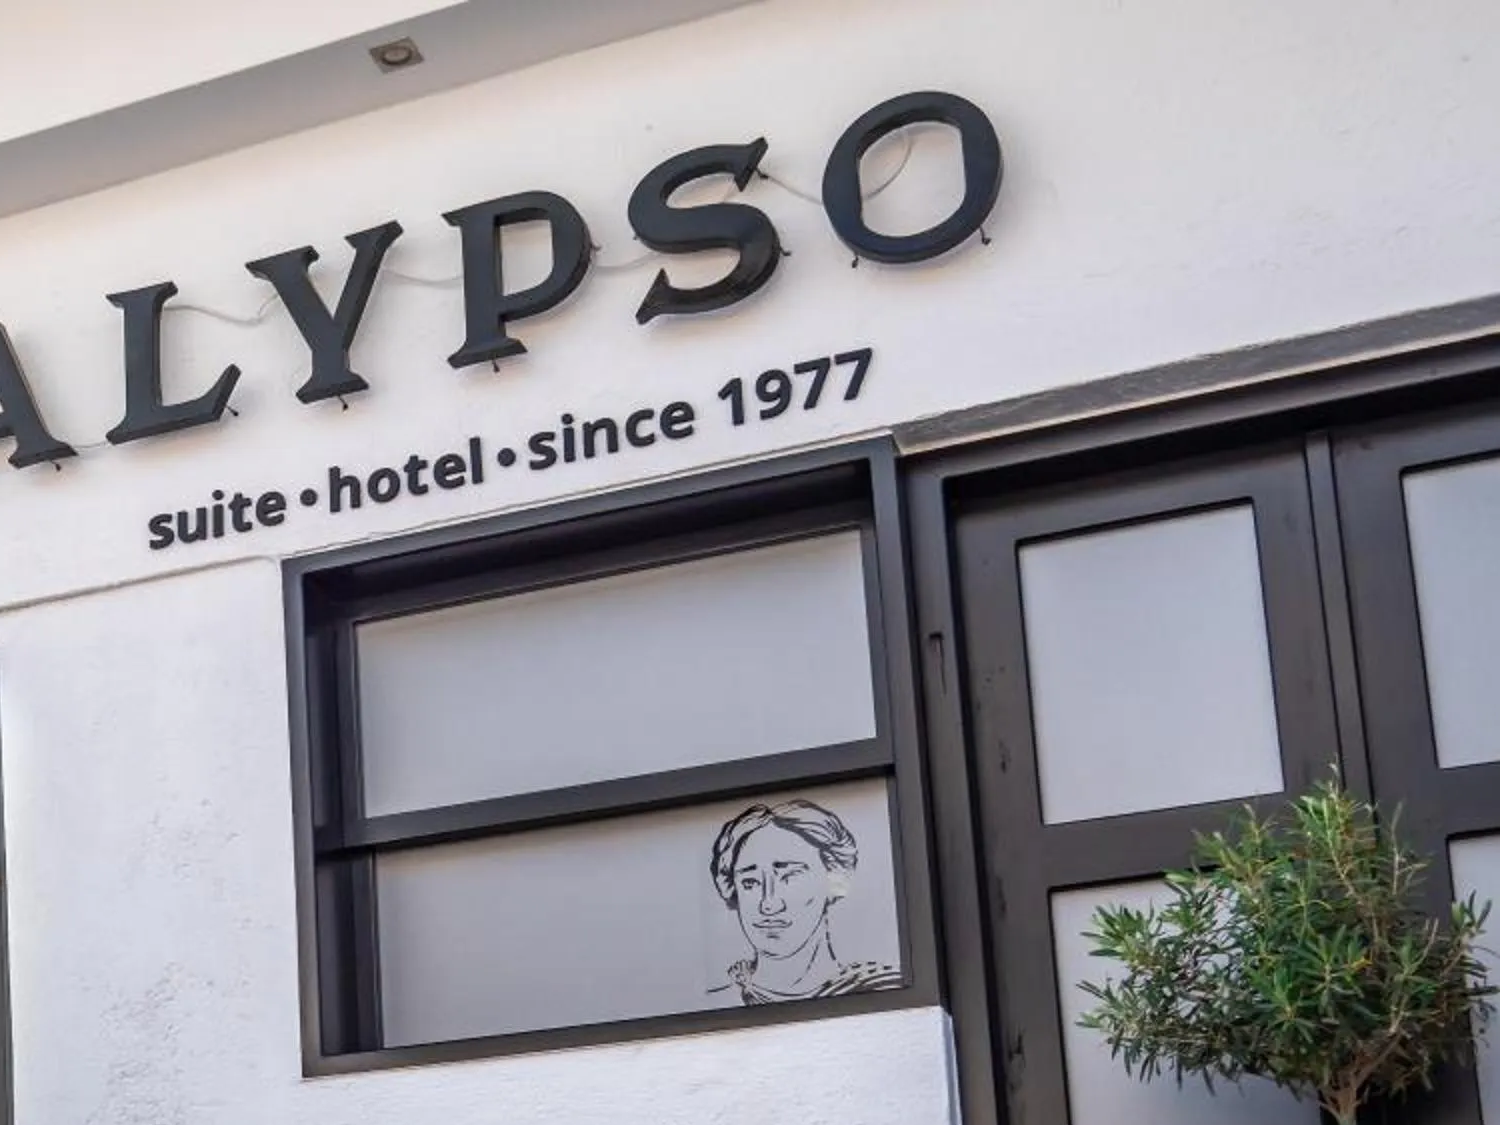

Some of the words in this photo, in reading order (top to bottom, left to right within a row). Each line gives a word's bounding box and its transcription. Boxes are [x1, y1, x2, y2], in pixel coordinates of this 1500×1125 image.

[148, 489, 287, 550] suite
[328, 437, 484, 513] hotel
[528, 401, 695, 471] since
[717, 347, 873, 426] 1977
